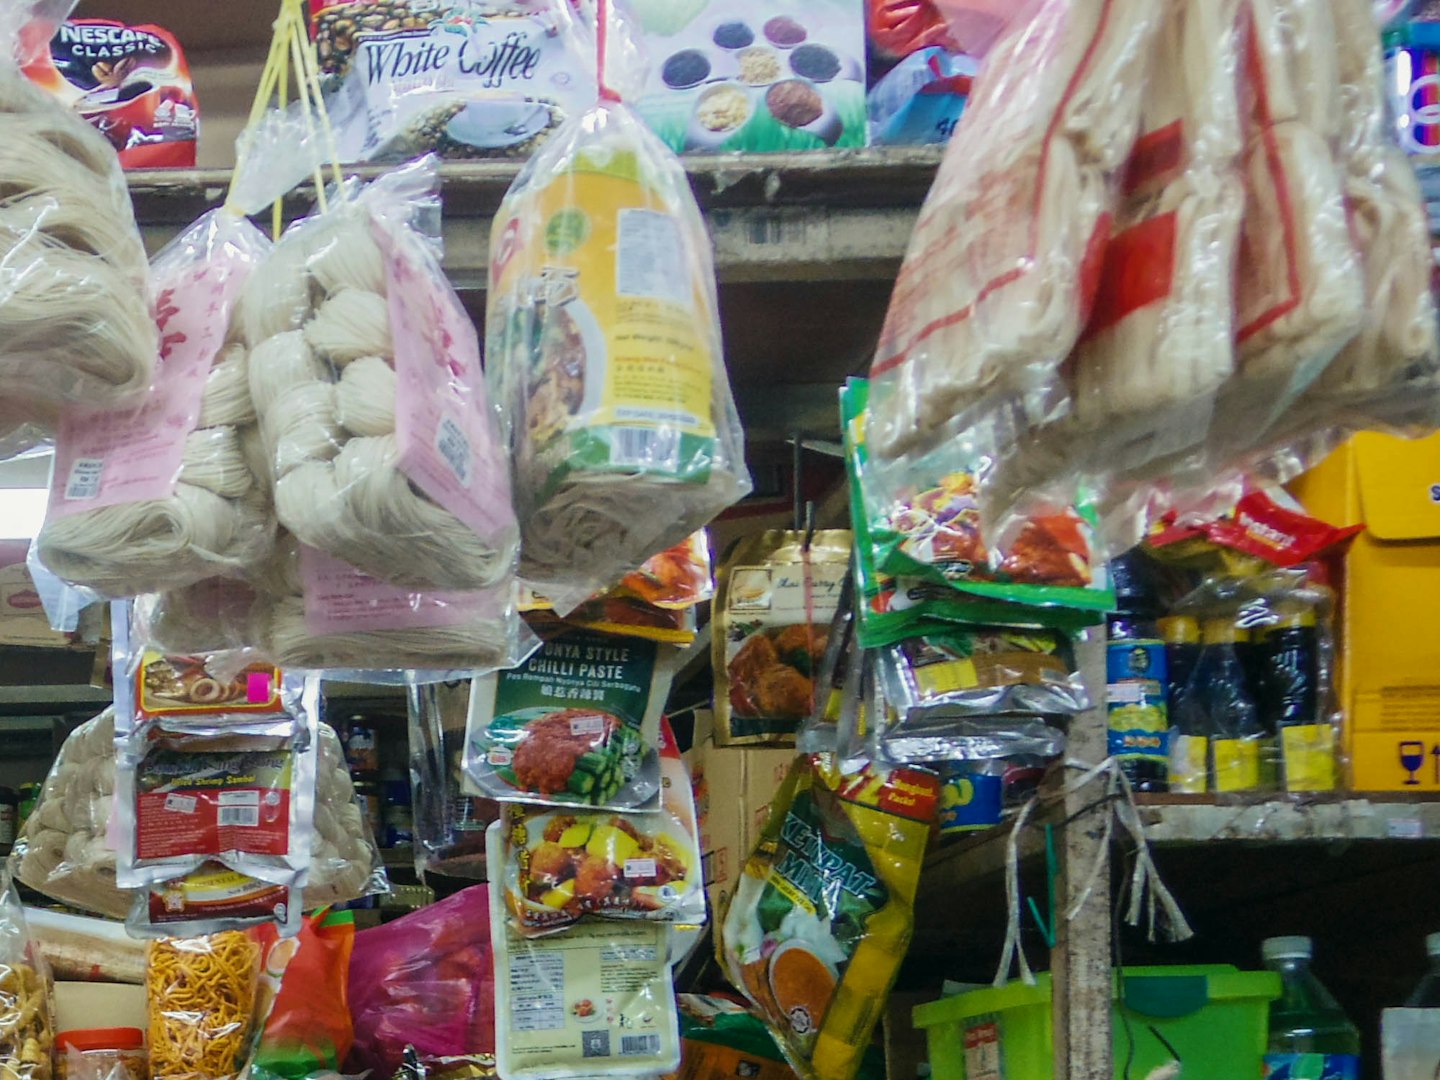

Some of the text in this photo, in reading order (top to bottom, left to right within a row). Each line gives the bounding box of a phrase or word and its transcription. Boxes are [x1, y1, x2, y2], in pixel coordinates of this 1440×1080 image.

[71, 42, 158, 59] CLASSIC
[364, 32, 541, 88] White Coffee
[585, 647, 629, 662] STYLE
[528, 658, 624, 680] CHILLI PASTE
